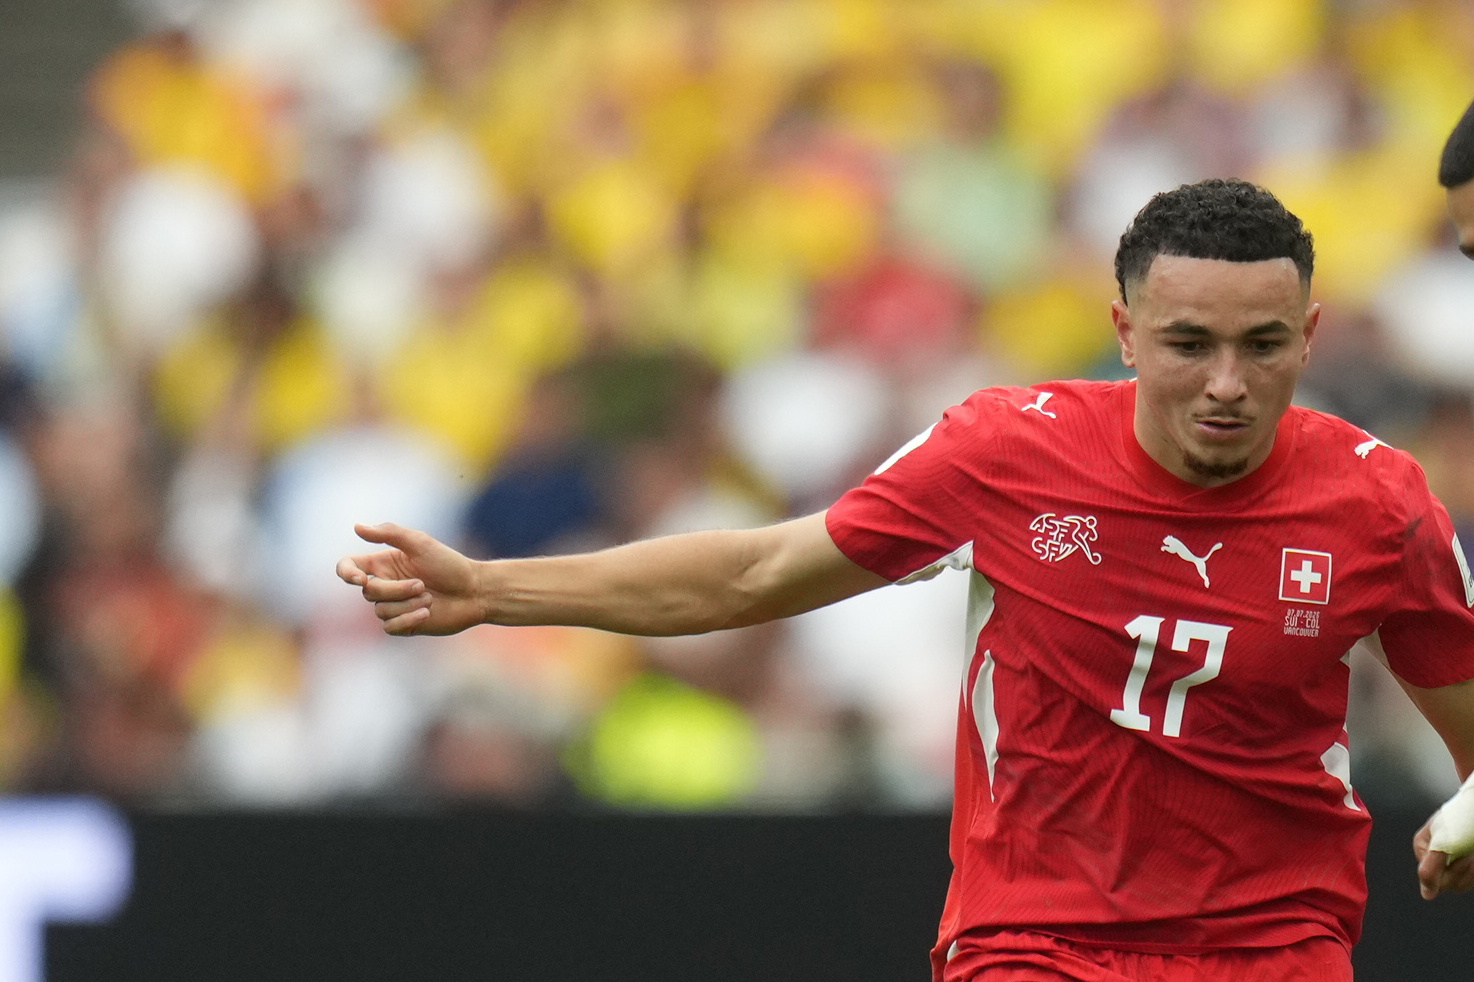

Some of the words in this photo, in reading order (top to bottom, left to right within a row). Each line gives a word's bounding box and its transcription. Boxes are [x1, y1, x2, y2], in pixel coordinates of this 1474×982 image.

[1286, 608, 1321, 619] 07.07.2026
[1284, 615, 1299, 627] SUI
[1305, 618, 1320, 629] COL
[1283, 626, 1320, 638] VANCOUVER
[1109, 614, 1235, 738] 17
